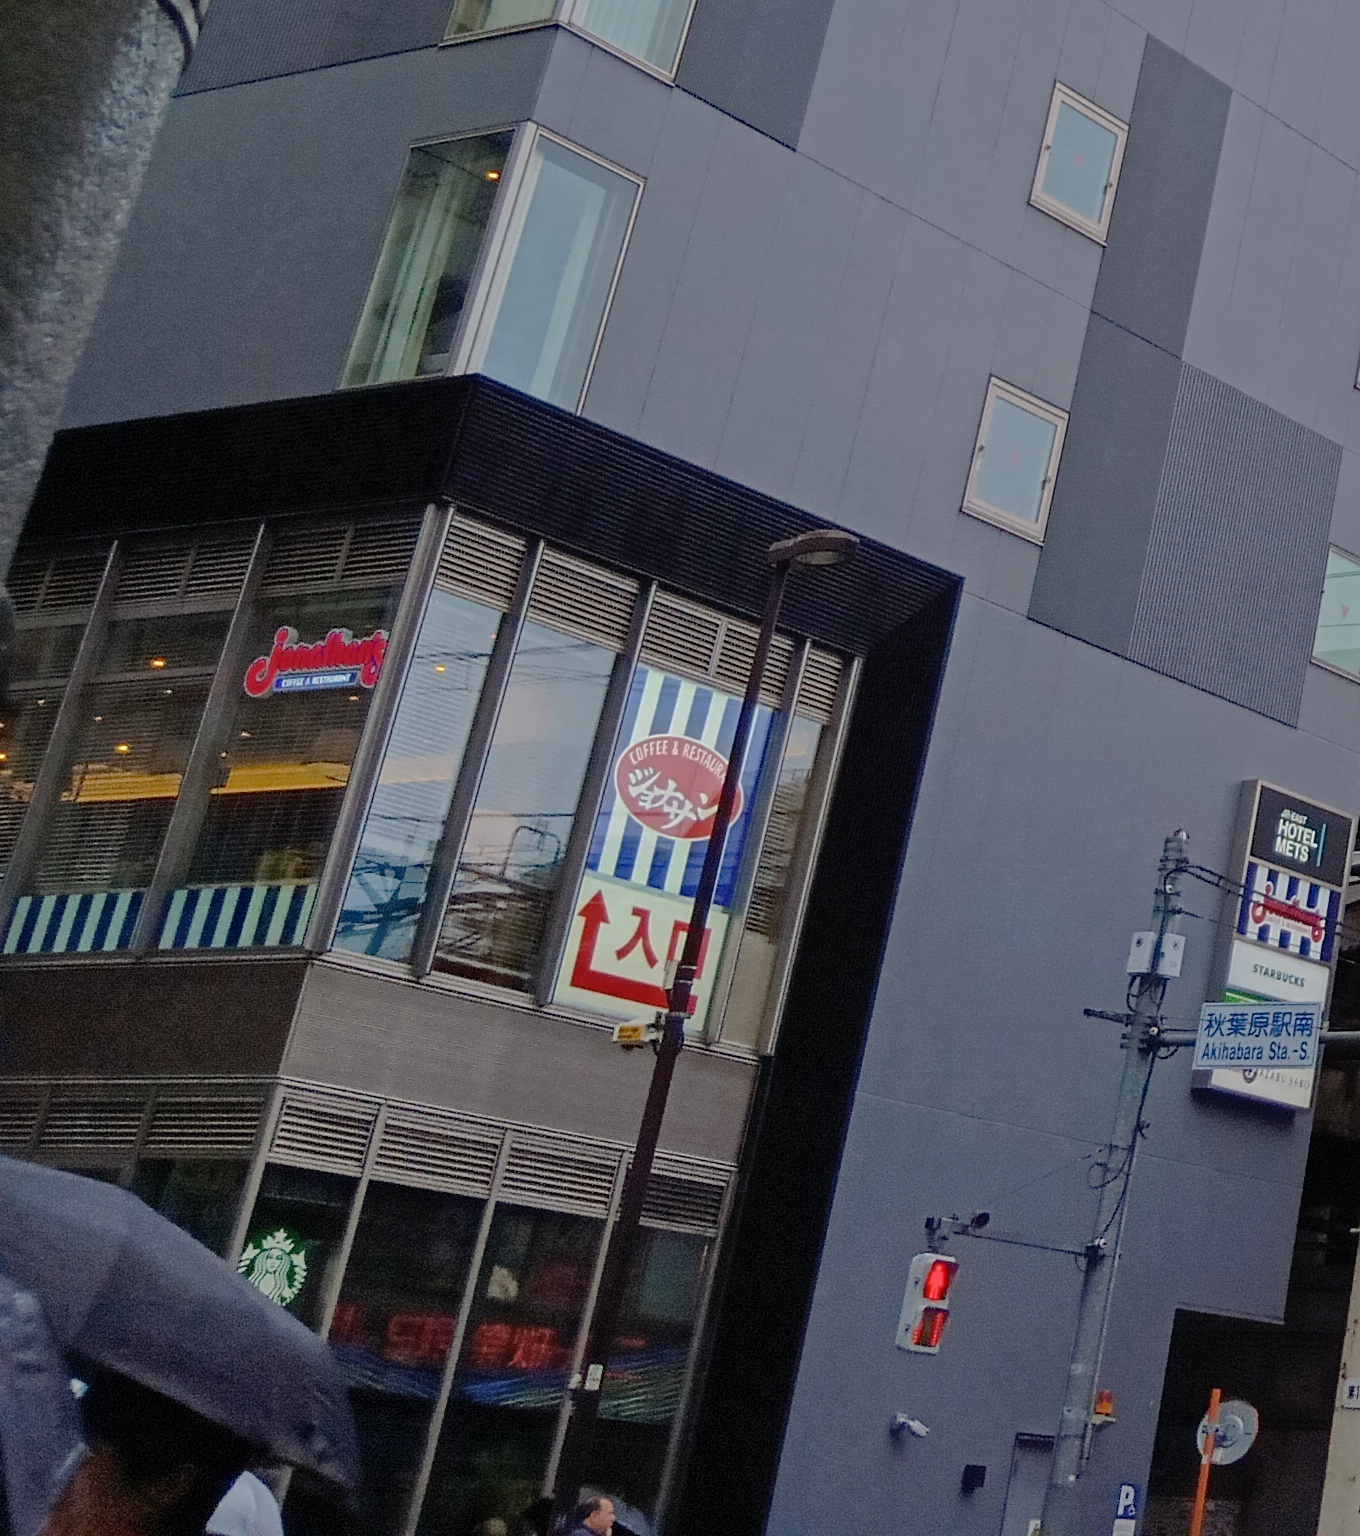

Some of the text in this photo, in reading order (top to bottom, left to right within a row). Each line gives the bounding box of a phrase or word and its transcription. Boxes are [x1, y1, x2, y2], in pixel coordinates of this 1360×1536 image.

[628, 739, 669, 766] COFFEE
[671, 740, 679, 756] &
[1278, 818, 1319, 849] HOTEL
[1274, 835, 1310, 863] METS
[1253, 964, 1306, 988] STARBUCKS
[1203, 1011, 1316, 1038] 秋葉原駅南
[1201, 1042, 1264, 1061] Akihabara
[1117, 1485, 1135, 1516] P
